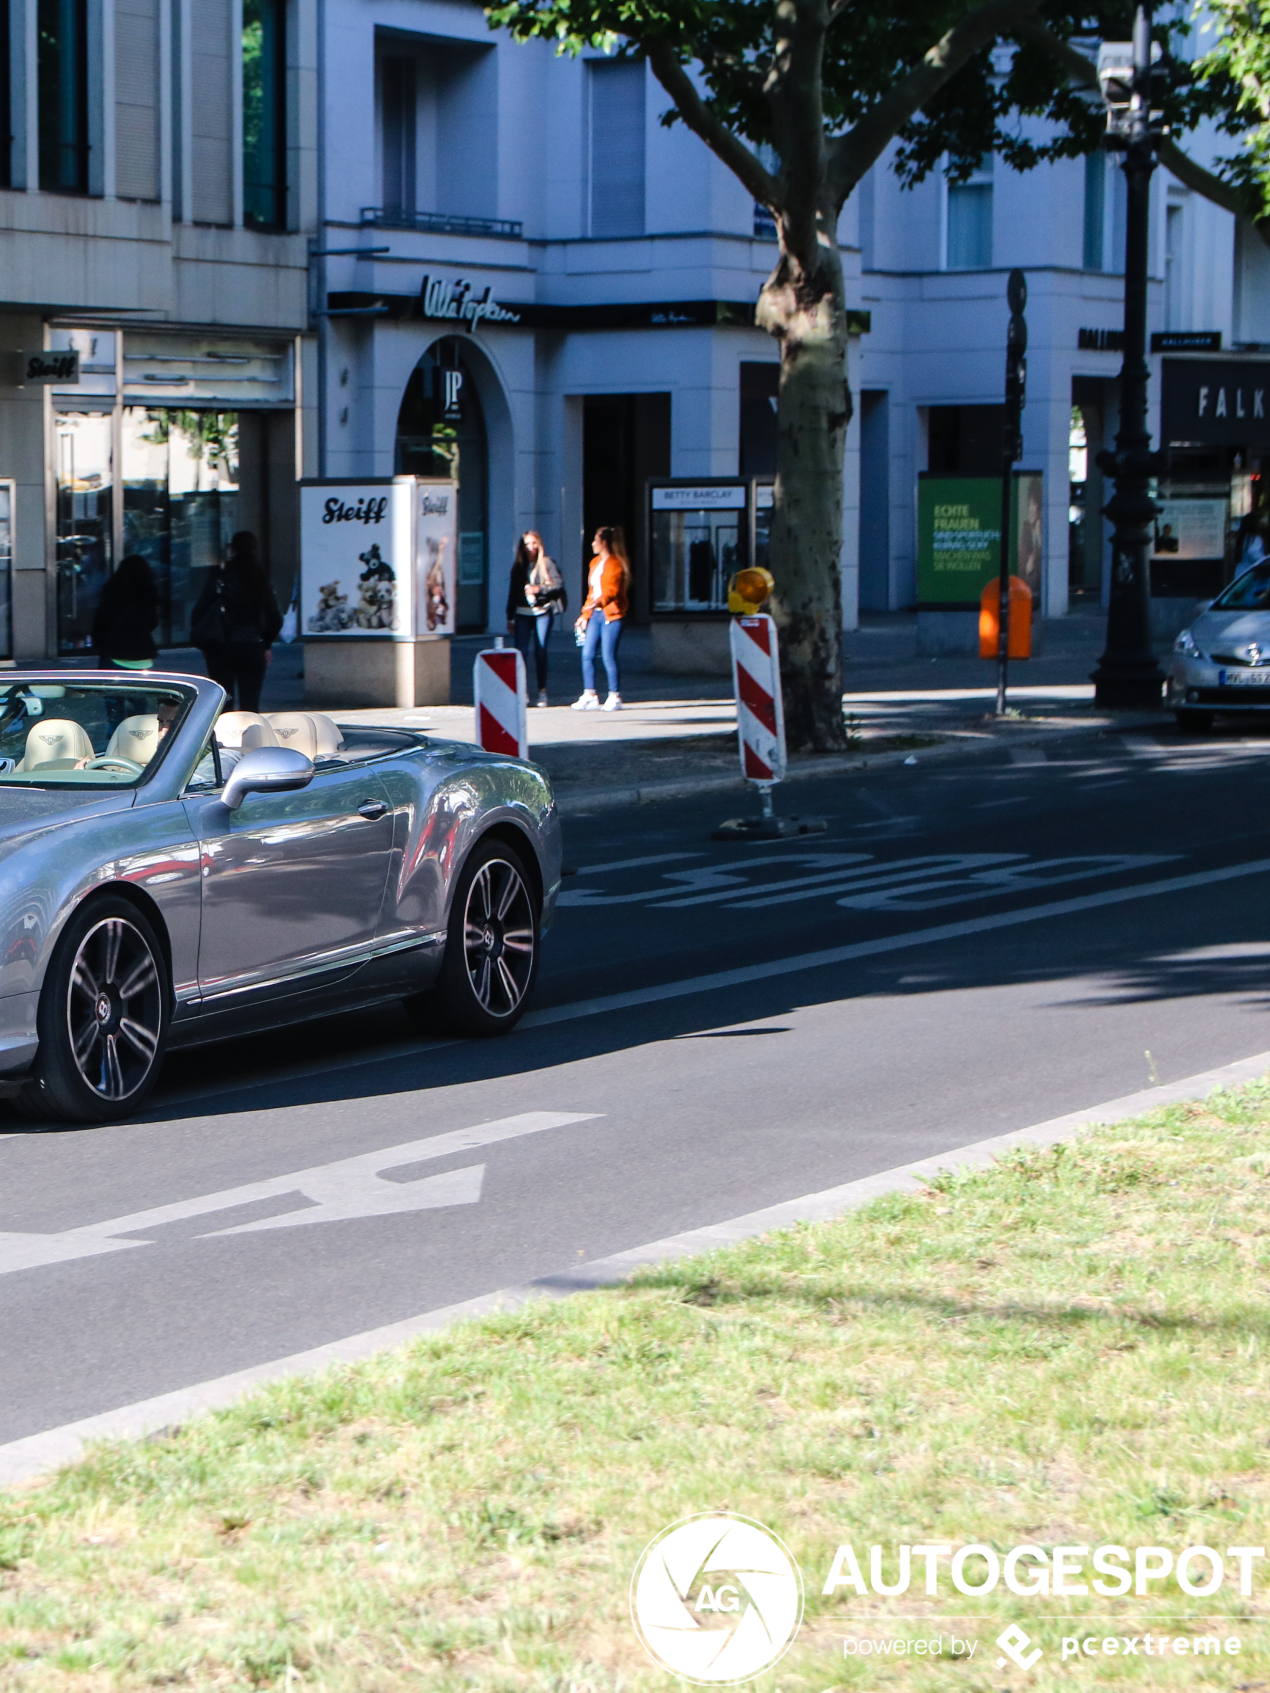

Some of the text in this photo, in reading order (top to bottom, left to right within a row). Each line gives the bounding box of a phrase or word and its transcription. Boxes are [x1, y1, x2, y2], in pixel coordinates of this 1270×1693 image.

[421, 275, 459, 319] Ulla
[26, 356, 76, 380] Steiff
[444, 371, 463, 411] JP
[664, 489, 733, 501] BETTY BARCLAY
[322, 497, 388, 525] Steiff
[934, 505, 969, 517] ECHTE
[934, 518, 980, 530] FRAUEN
